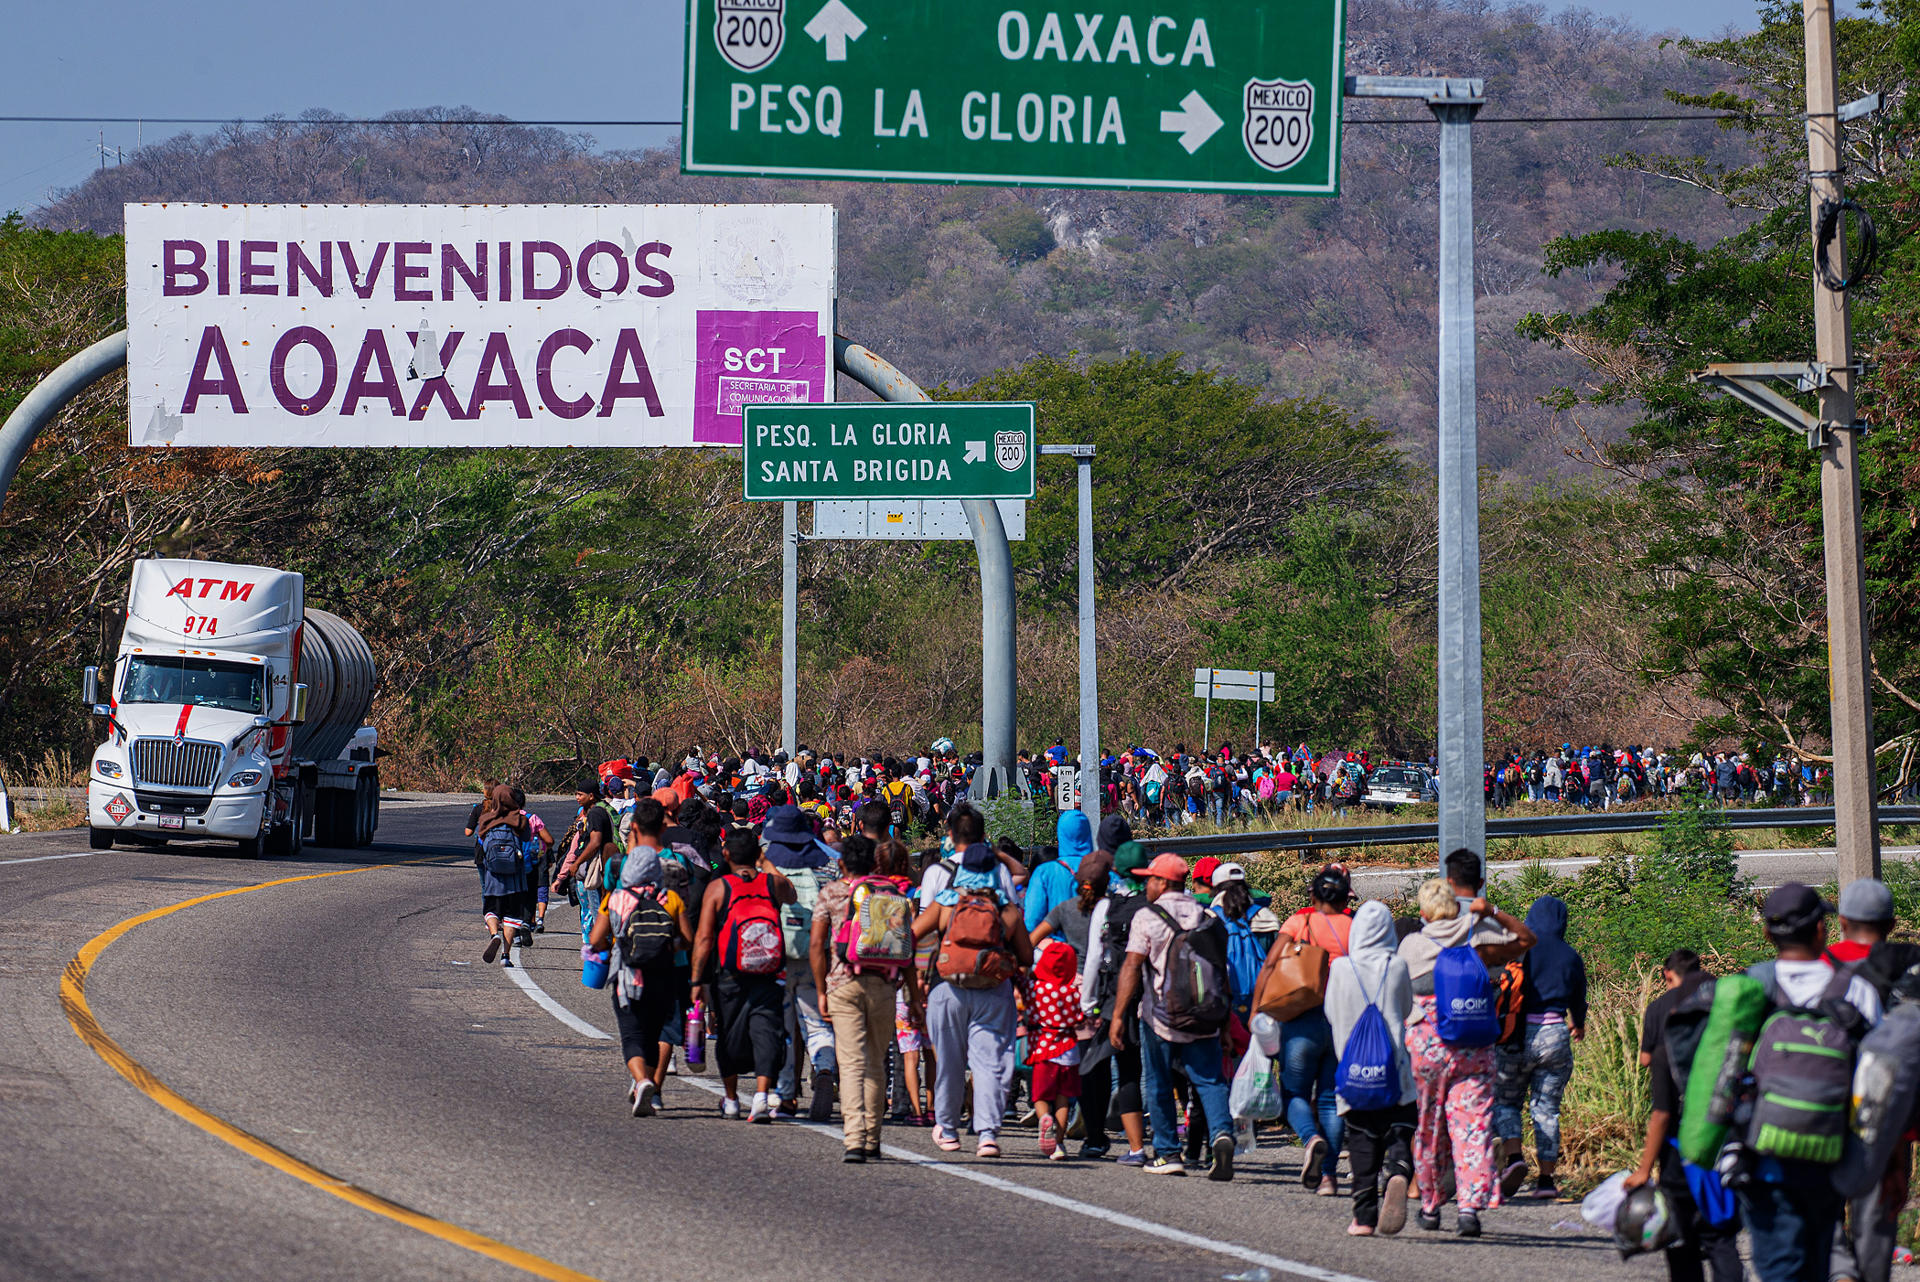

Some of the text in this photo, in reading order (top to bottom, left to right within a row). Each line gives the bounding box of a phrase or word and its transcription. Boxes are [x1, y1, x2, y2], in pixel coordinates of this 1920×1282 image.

[726, 16, 773, 48] 200
[998, 11, 1216, 67] OAXACA
[1253, 89, 1306, 107] MEXICO
[730, 83, 1126, 145] PESQ LA GLORIA
[1255, 115, 1301, 147] 200
[163, 240, 675, 302] BIENVENIDOS
[724, 347, 786, 374] SCT
[180, 326, 664, 422] A OAXACA
[729, 381, 791, 393] SECRETARIA DE
[756, 423, 951, 447] PESQ. LA GLORIA
[998, 434, 1022, 443] MEXICO
[1001, 446, 1020, 461] 200
[761, 459, 951, 482] SANTA BRIGIDA
[165, 577, 256, 602] ATM
[184, 615, 218, 635] 974
[1464, 998, 1488, 1010] OIM
[1361, 1064, 1387, 1078] OIM
